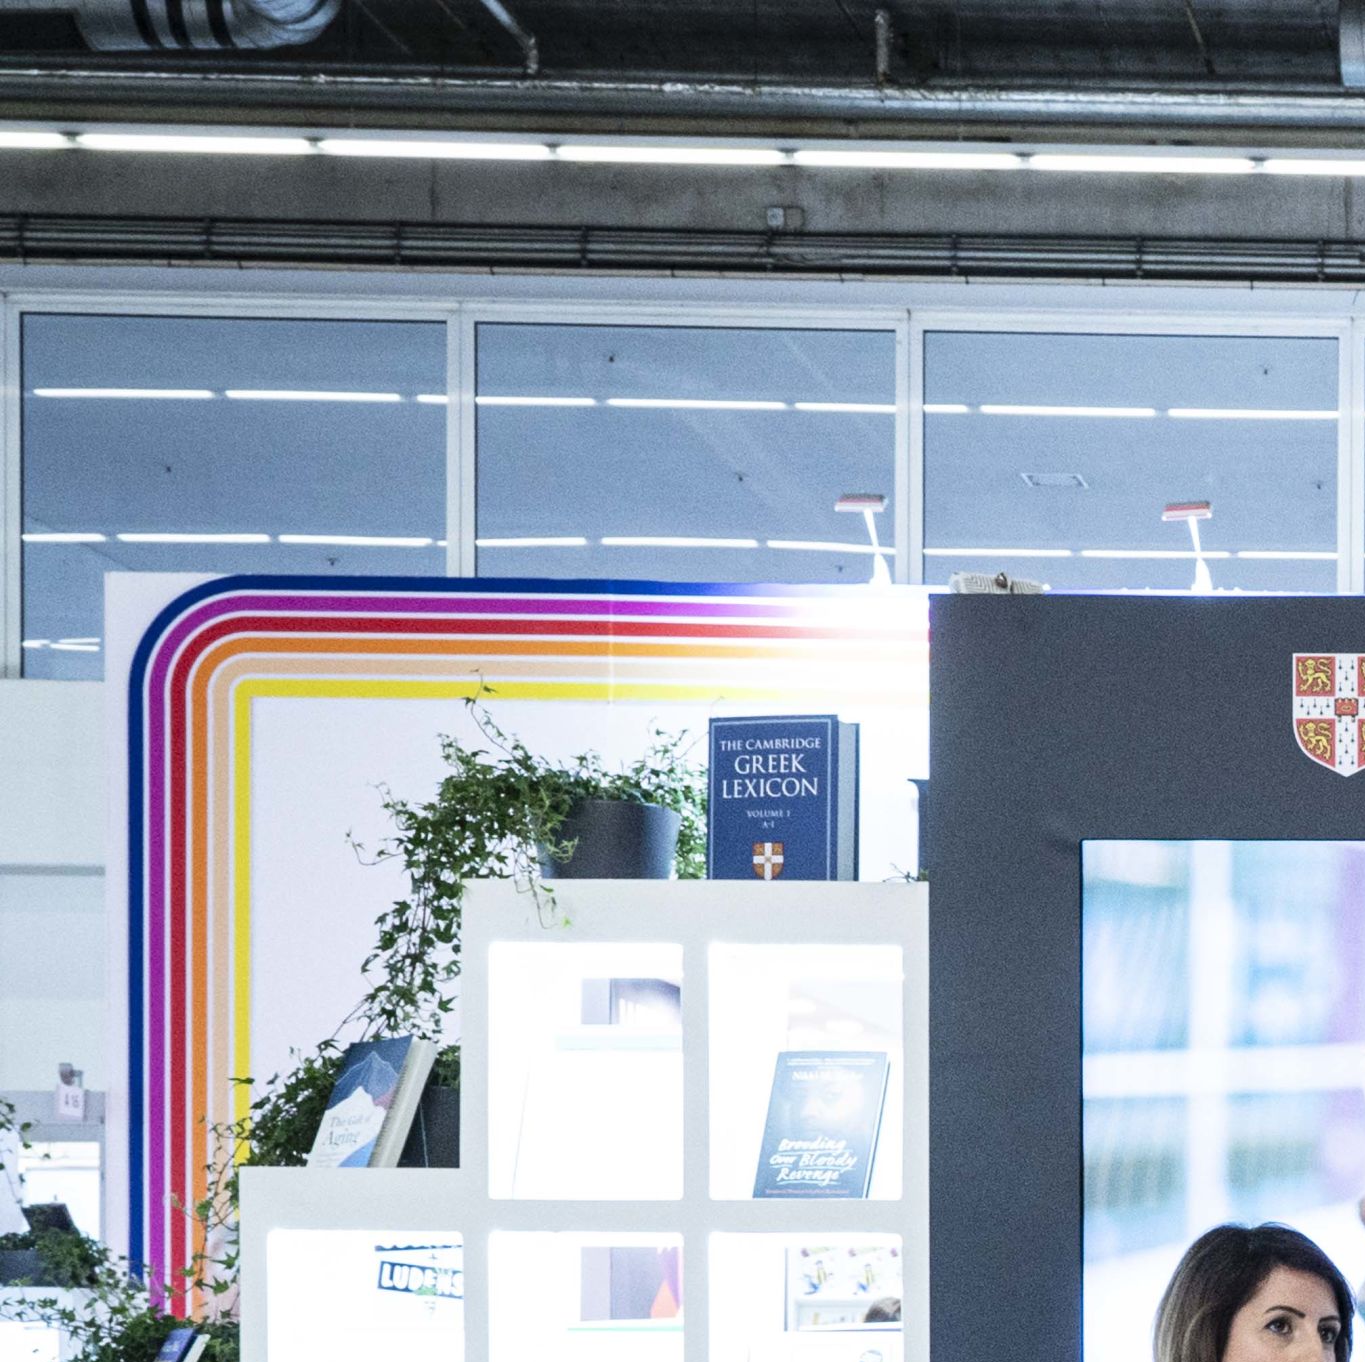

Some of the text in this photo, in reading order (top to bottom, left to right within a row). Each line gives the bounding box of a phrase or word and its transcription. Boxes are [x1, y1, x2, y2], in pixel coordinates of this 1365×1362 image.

[719, 737, 822, 751] THE CAMBRIDGE
[734, 753, 807, 775] GREEK
[722, 777, 818, 799] LEXICON
[747, 809, 784, 818] VOLUME
[778, 1136, 847, 1155] Brooding
[798, 1153, 858, 1174] Bloody
[776, 1167, 840, 1187] Revenge
